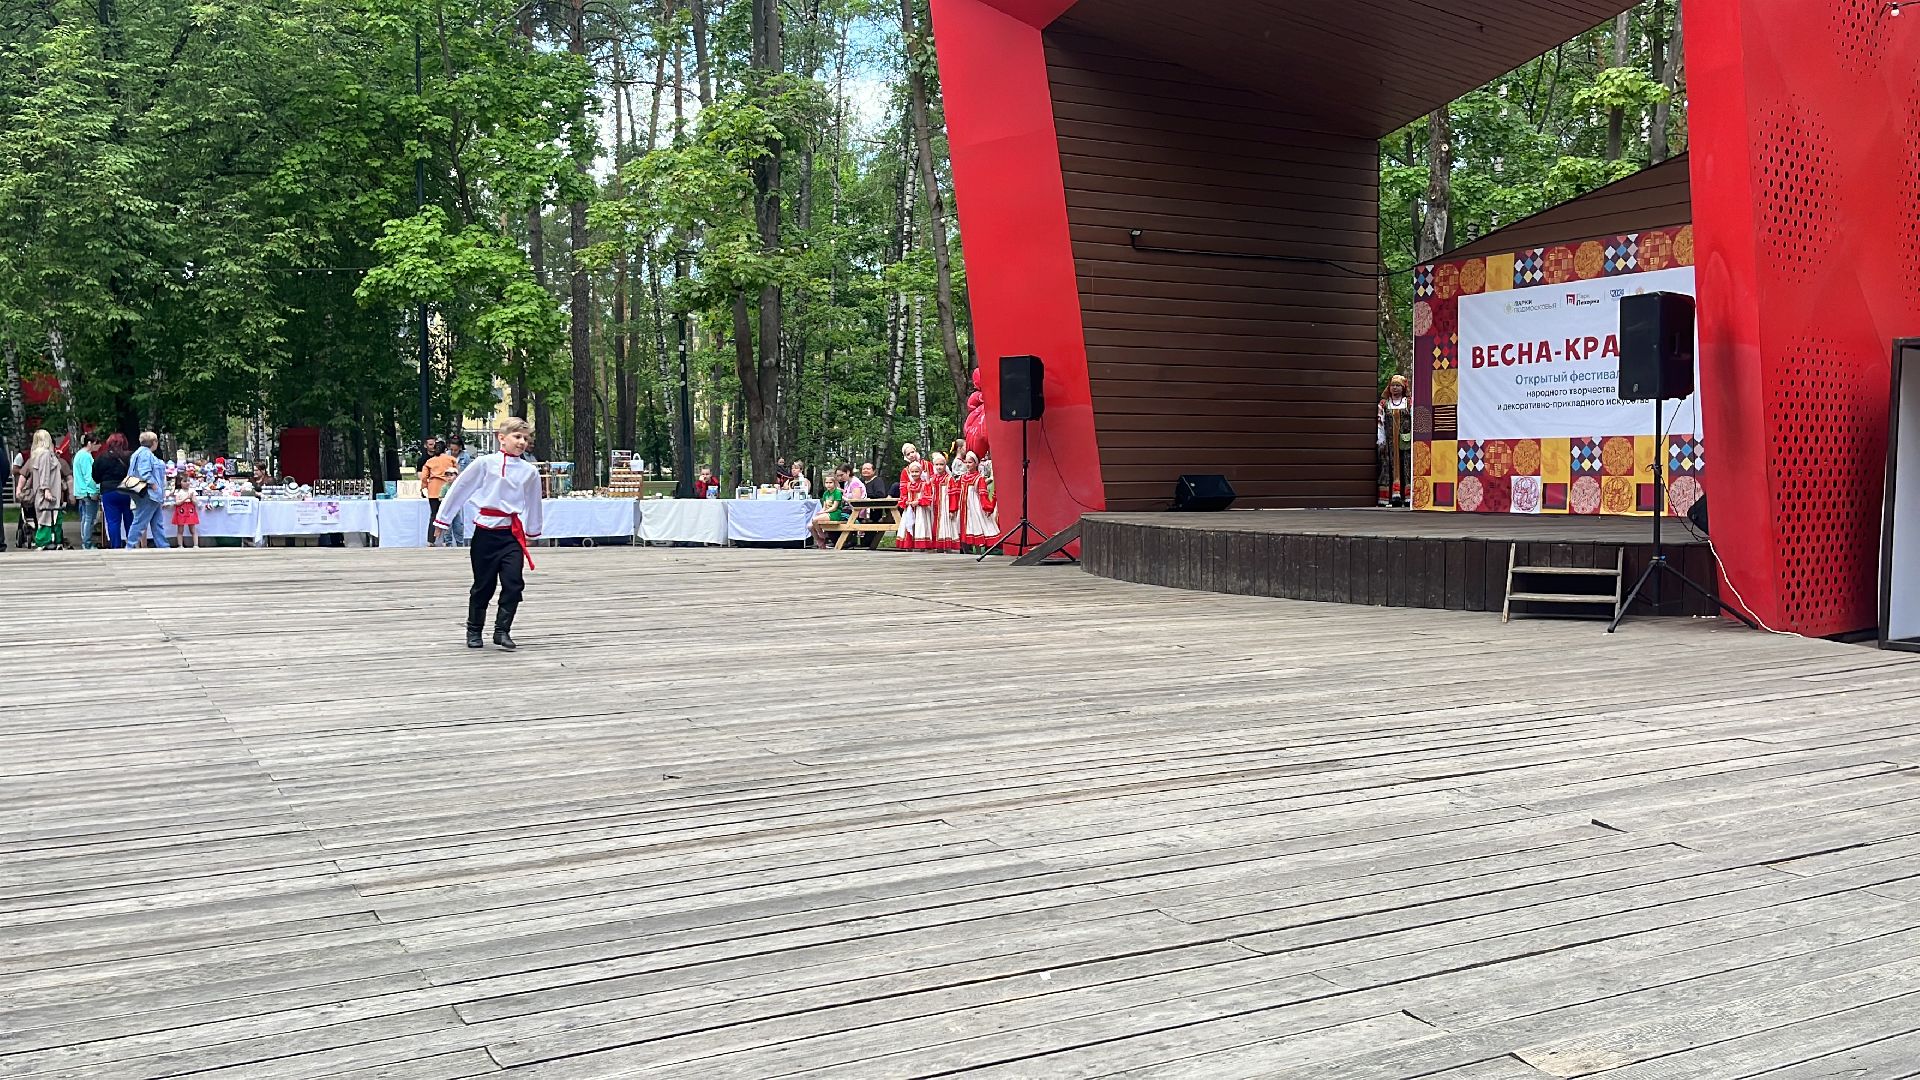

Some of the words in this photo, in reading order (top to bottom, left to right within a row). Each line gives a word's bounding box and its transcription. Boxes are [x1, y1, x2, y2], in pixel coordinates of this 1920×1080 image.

[1515, 371, 1567, 386] Открытый
[1526, 389, 1568, 397] народного
[1569, 386, 1616, 395] творчества
[1503, 397, 1604, 410] декоративно-прикладного
